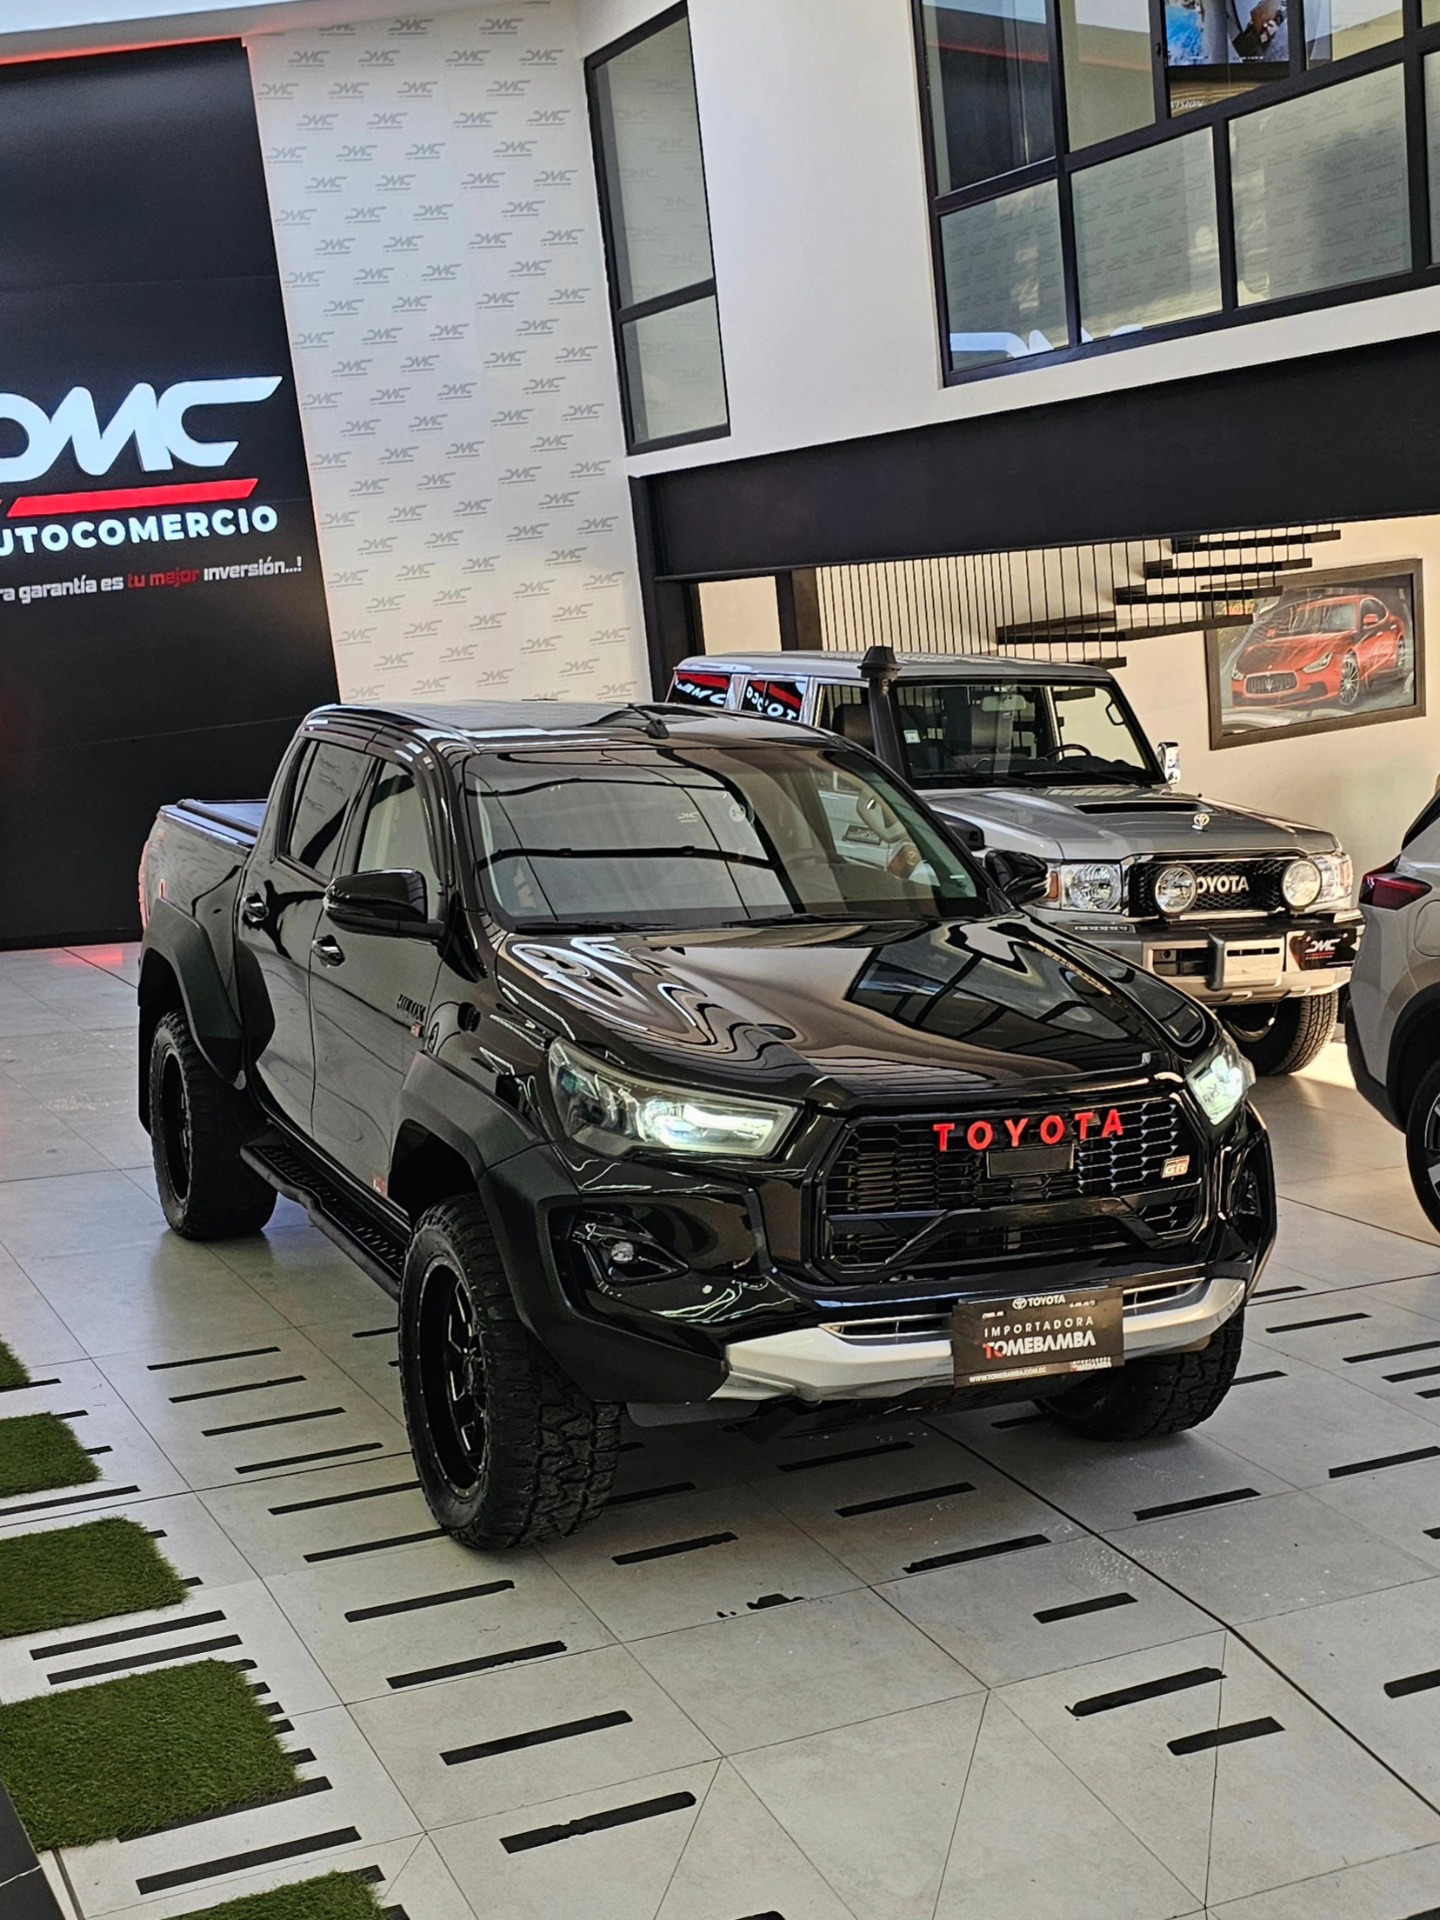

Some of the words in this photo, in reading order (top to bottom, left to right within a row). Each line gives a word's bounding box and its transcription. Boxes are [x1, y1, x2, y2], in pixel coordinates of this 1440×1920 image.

[19, 574, 97, 605] garantía
[101, 577, 124, 592] es
[127, 573, 147, 589] tu
[150, 567, 200, 588] mejor
[1197, 876, 1249, 894] OYOTA
[933, 1109, 1124, 1152] TOYOTA
[1028, 1294, 1066, 1307] TOYOTA
[984, 1316, 1094, 1338] IMPORTADORA
[982, 1330, 1096, 1360] TOMEBAMBA
